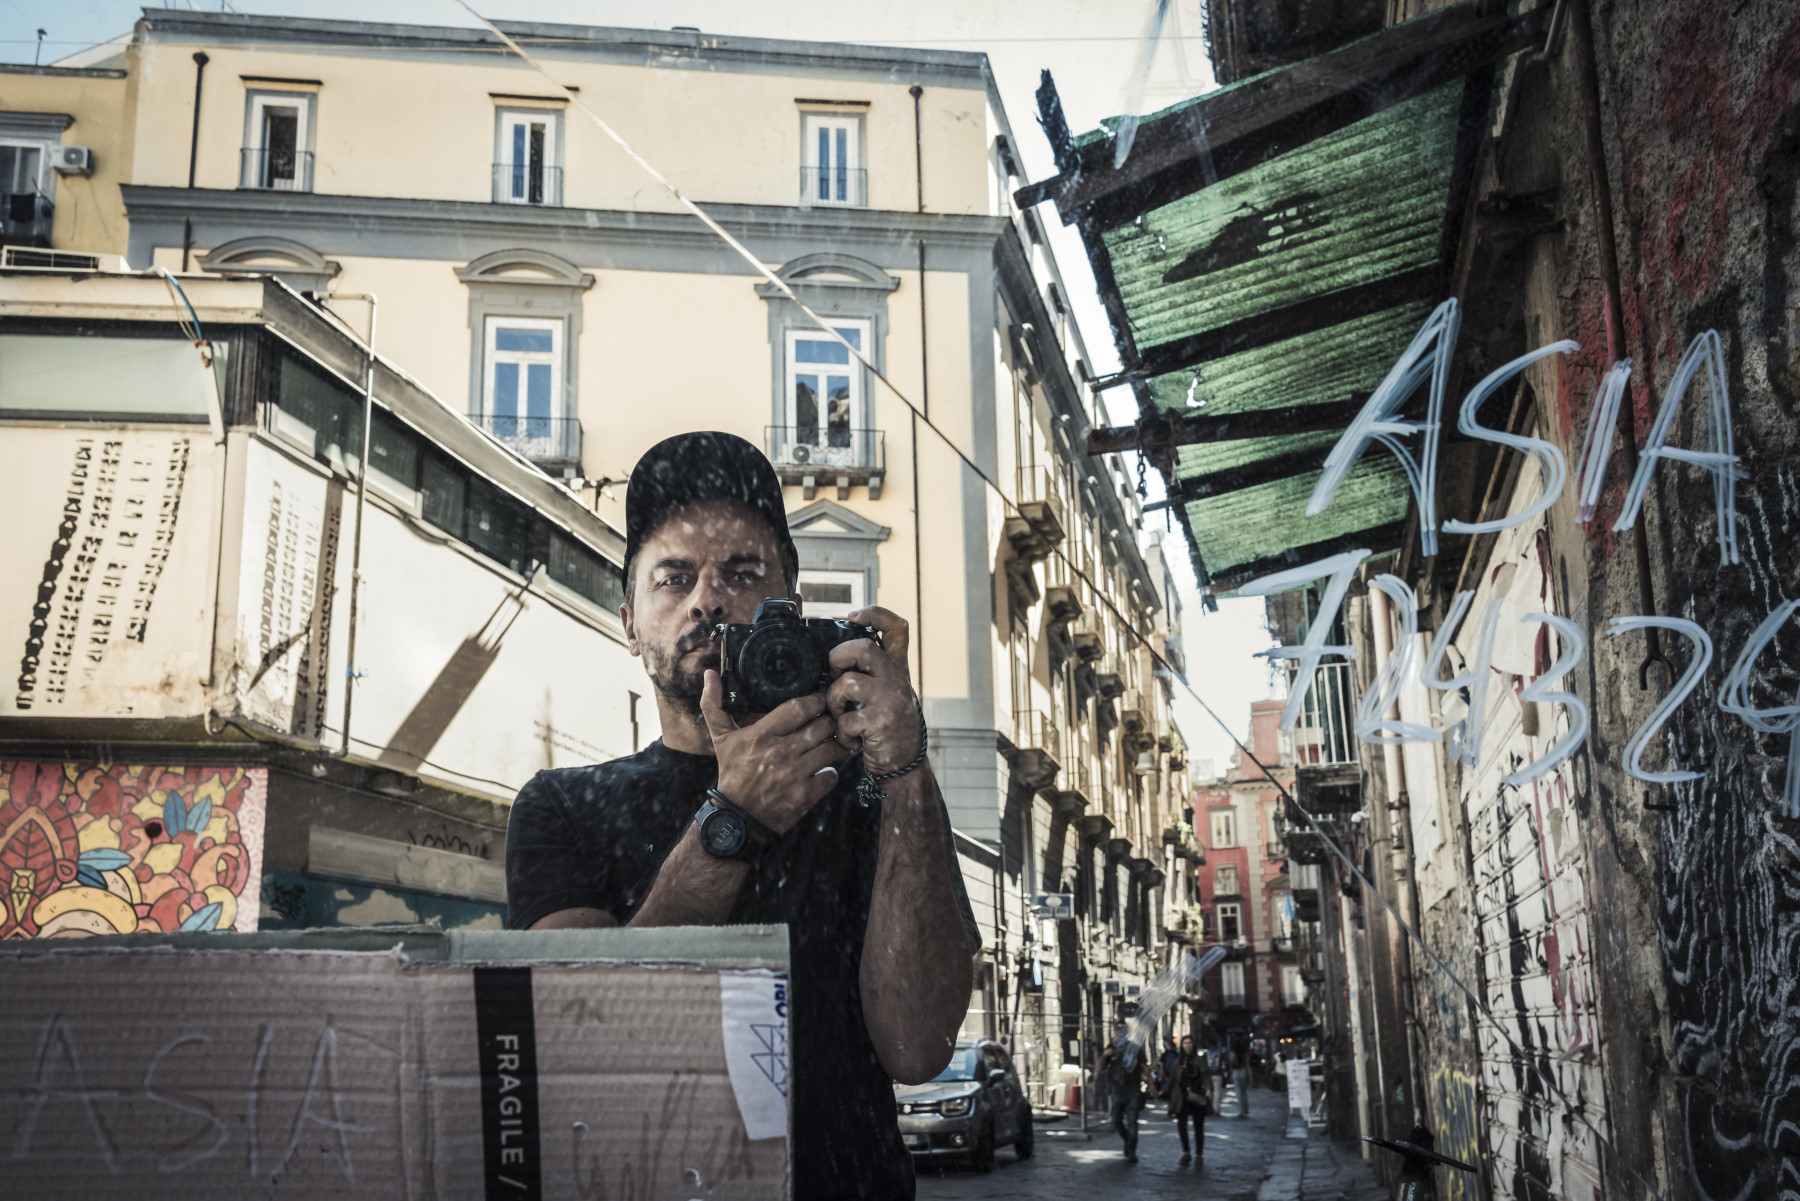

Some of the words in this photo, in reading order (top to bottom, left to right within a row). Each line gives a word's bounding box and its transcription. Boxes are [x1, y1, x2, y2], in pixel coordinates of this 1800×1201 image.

[1305, 296, 1749, 566] ASIA
[12, 1012, 376, 1184] ASIA
[495, 1034, 525, 1165] FRAGILE
